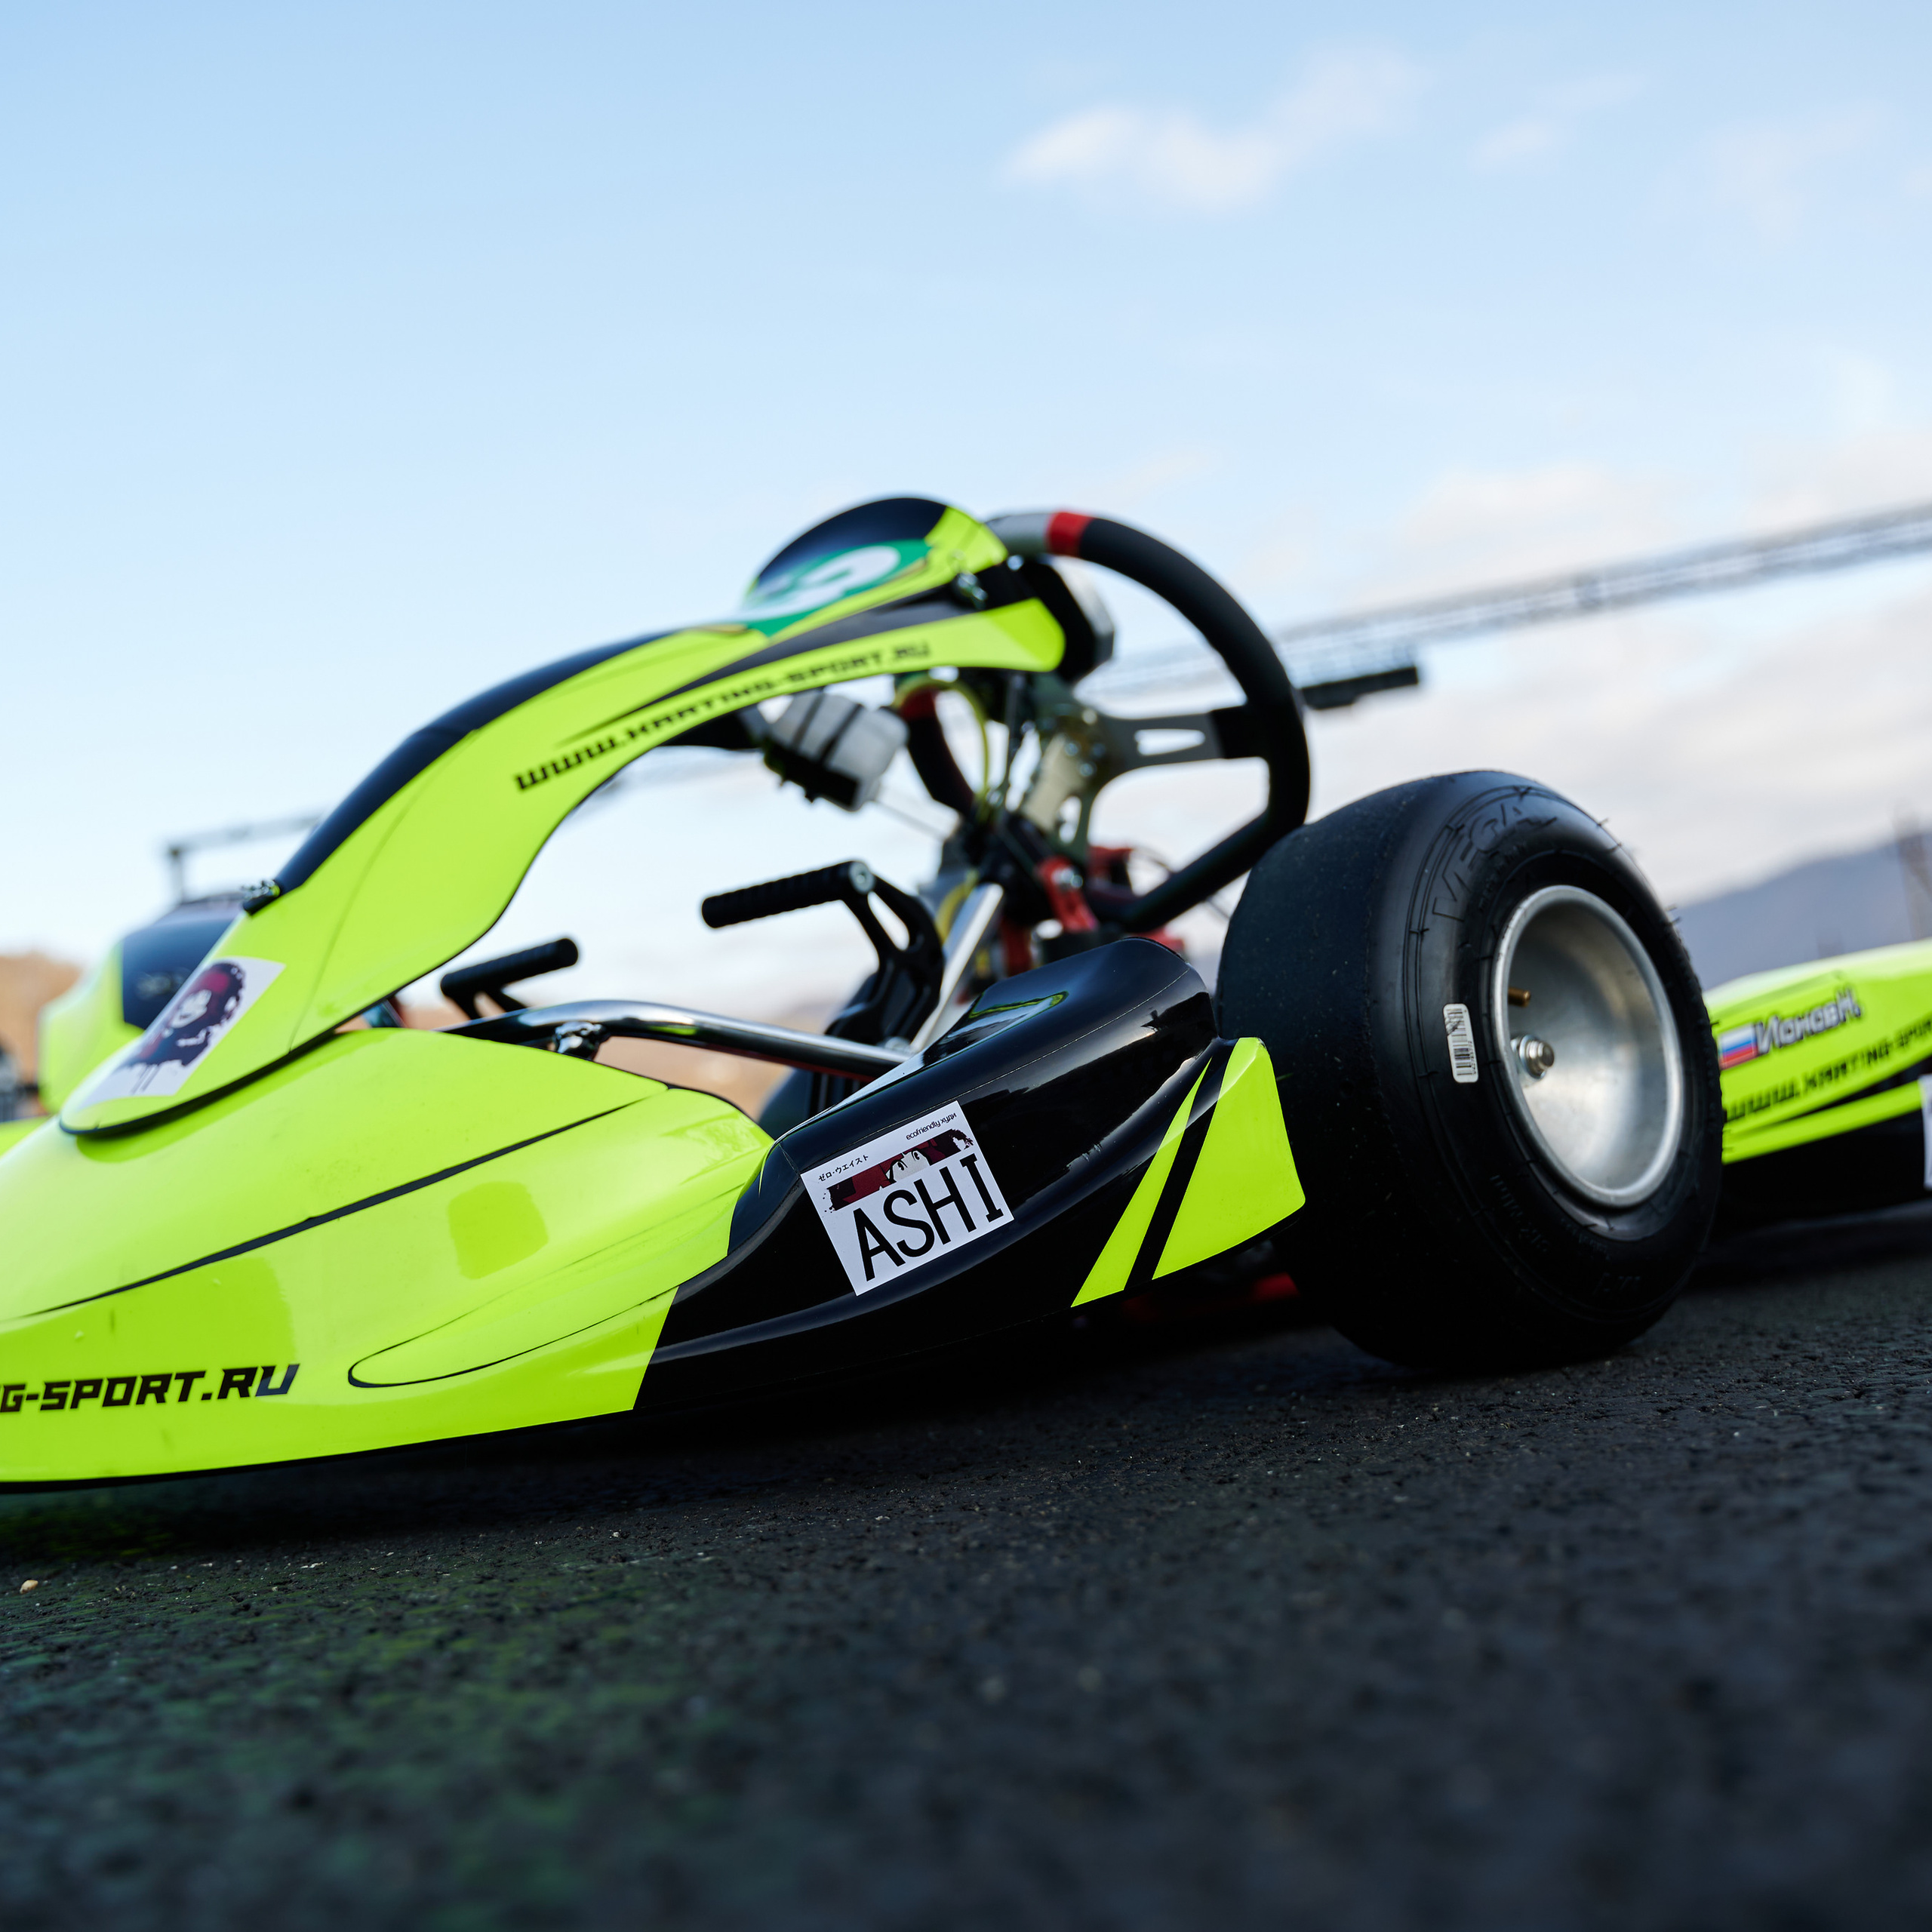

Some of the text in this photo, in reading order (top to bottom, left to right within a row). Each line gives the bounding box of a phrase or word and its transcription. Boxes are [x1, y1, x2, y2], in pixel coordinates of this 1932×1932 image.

[906, 1112, 957, 1140] ecofriendly худи
[853, 1153, 1004, 1282] ASHI
[0, 1364, 300, 1413] G-SPORT.RU
